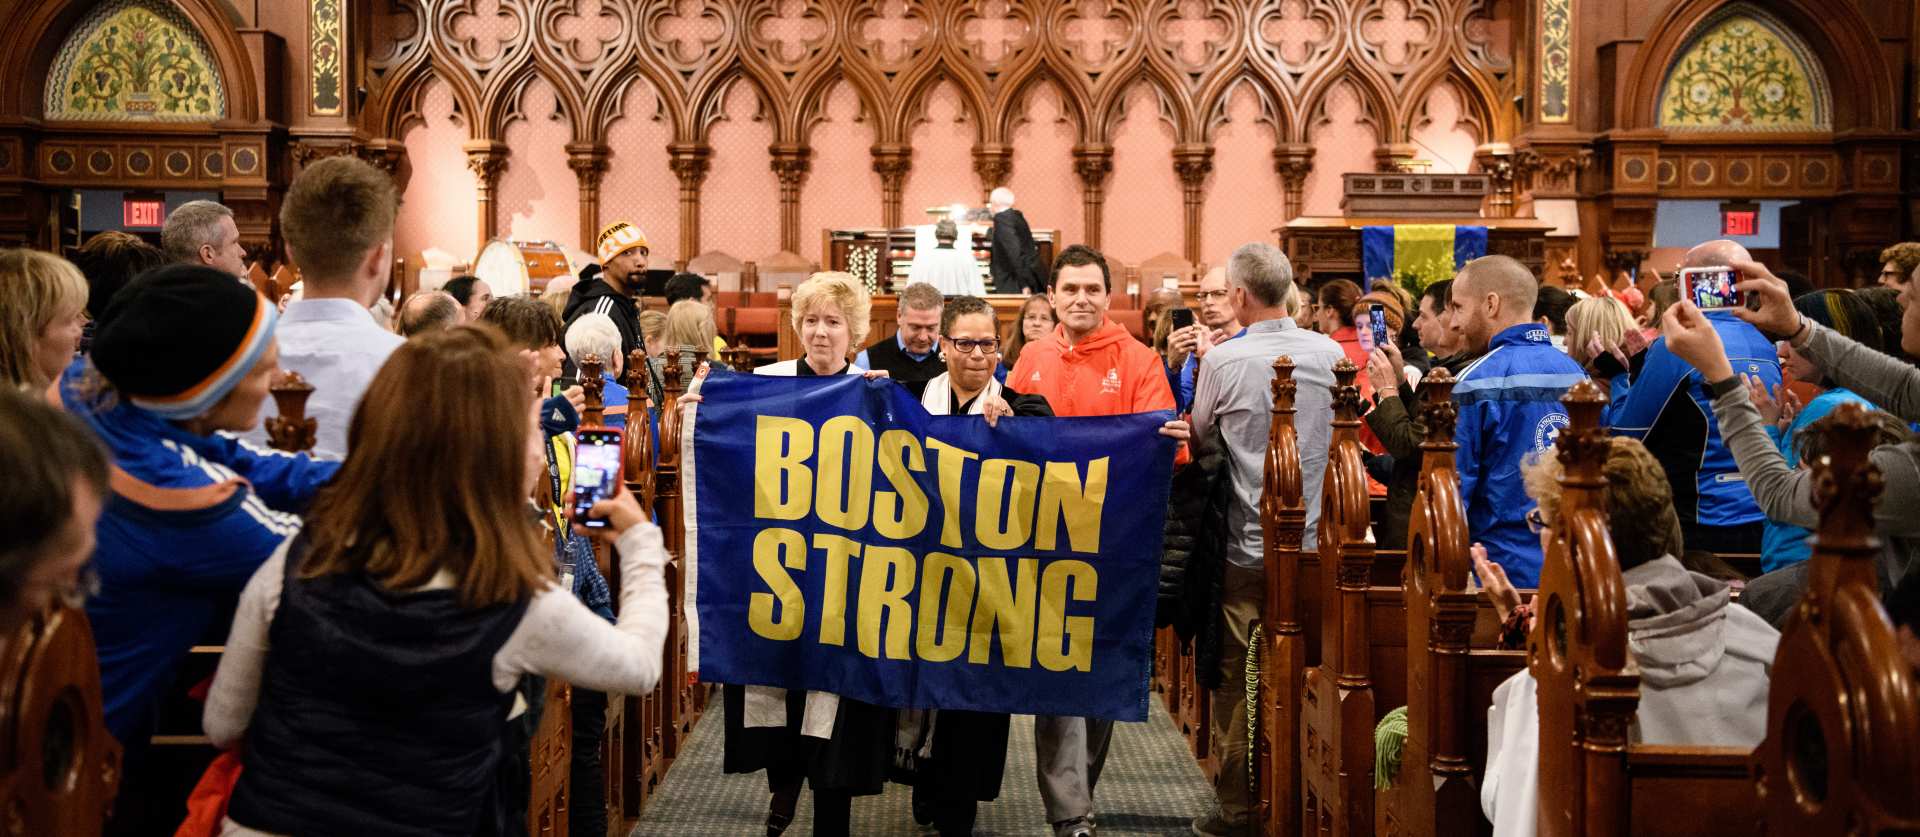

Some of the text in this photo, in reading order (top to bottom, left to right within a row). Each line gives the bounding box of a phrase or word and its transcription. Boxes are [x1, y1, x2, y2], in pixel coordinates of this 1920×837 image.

[131, 202, 160, 225] EXIT
[1727, 211, 1754, 235] EXIT
[754, 415, 1110, 554] BOSTON
[748, 527, 1099, 673] STRONG
